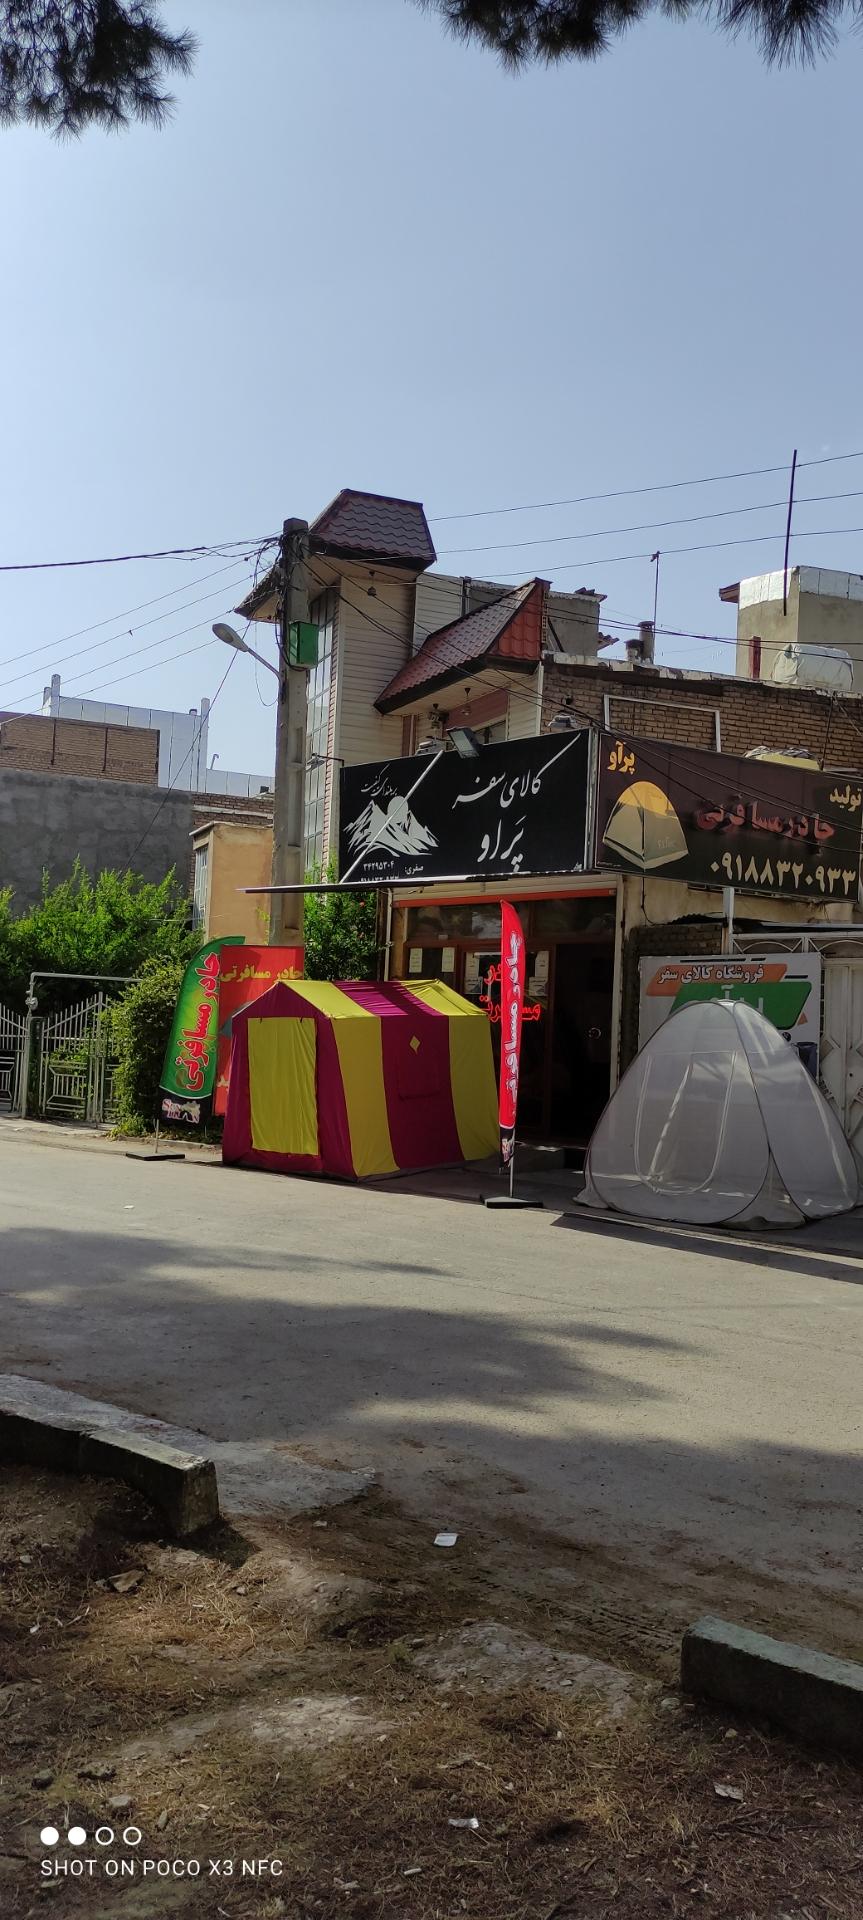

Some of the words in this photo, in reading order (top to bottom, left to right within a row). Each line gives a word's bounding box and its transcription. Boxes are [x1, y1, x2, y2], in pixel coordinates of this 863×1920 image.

[500, 733, 581, 808] کالای
[607, 740, 636, 775] پرآو
[452, 771, 506, 810] سفر
[710, 852, 857, 896] ۰۹۱۸۸۳۲۰۹۳۳
[658, 967, 679, 984] سفر
[681, 965, 713, 984] کالای
[716, 964, 764, 984] فروشگاه
